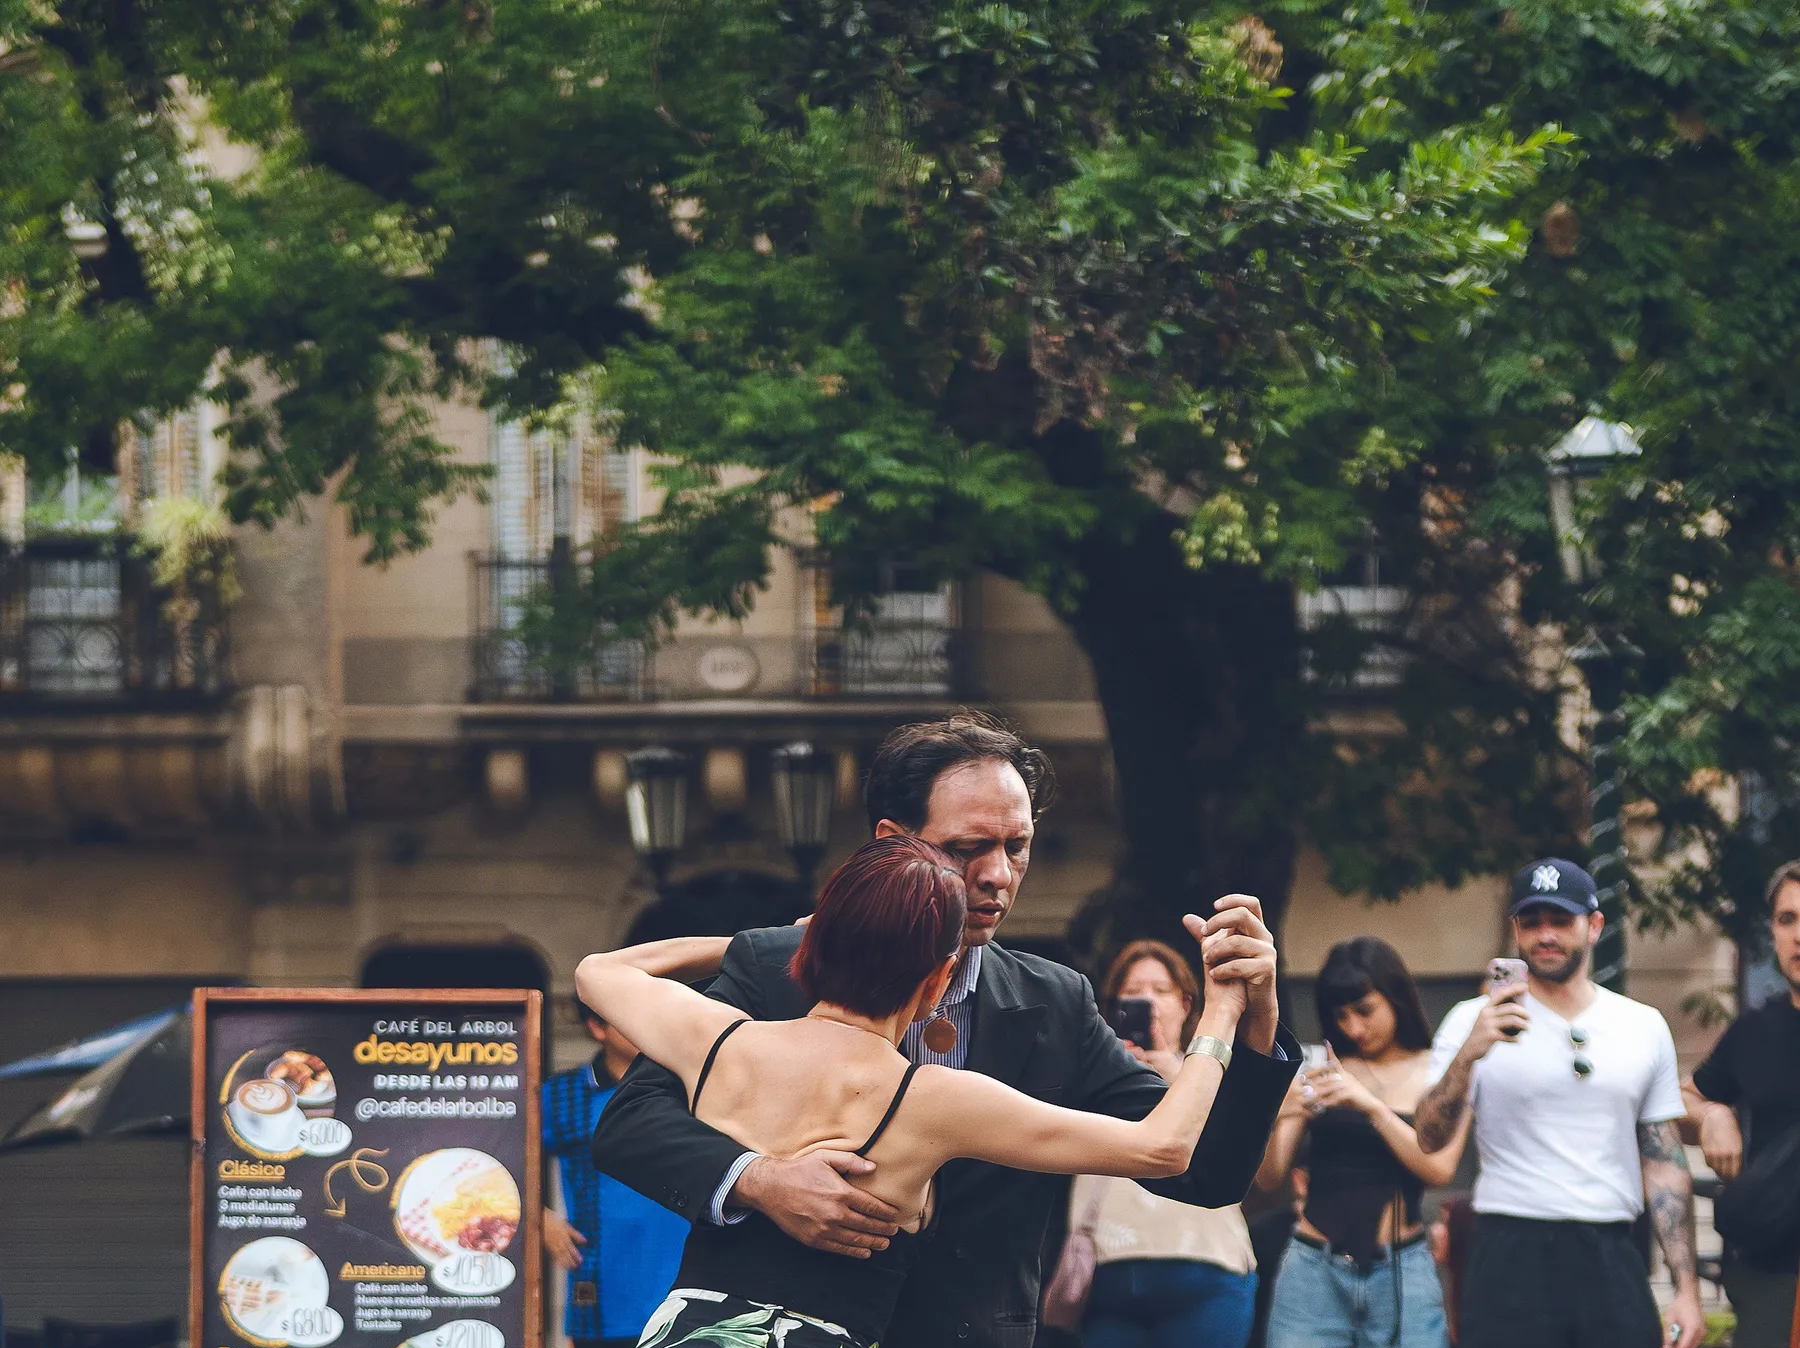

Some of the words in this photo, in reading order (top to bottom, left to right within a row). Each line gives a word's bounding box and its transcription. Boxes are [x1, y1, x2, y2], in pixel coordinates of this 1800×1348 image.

[1531, 865, 1560, 892] NY
[374, 1018, 419, 1034] CAFÉ
[423, 1021, 456, 1034] DEL
[460, 1021, 518, 1034] ARBOL
[353, 1033, 519, 1071] desayunos
[374, 1074, 431, 1090] DESDE
[432, 1074, 467, 1090] LAS
[469, 1074, 489, 1090] 10
[490, 1074, 519, 1090] AM
[355, 1096, 517, 1122] @cafedelarbol.ba
[219, 1160, 286, 1178] Clásico
[218, 1185, 247, 1199] Café
[248, 1187, 269, 1199] con
[270, 1186, 303, 1199] leche
[230, 1200, 296, 1214] medialunas
[218, 1214, 245, 1229] Jugo
[247, 1214, 262, 1227] de
[264, 1214, 307, 1230] naranja
[340, 1261, 426, 1278] Americano
[355, 1282, 380, 1294] Café
[381, 1284, 400, 1294] con
[401, 1282, 429, 1294] leche
[355, 1295, 393, 1307] Huevos
[394, 1295, 440, 1307] revueltos
[441, 1297, 460, 1307] con
[461, 1296, 501, 1308] panceta
[355, 1307, 380, 1320] Jugo
[380, 1307, 394, 1318] de
[395, 1308, 432, 1320] naranja
[356, 1319, 402, 1331] Tostadas
